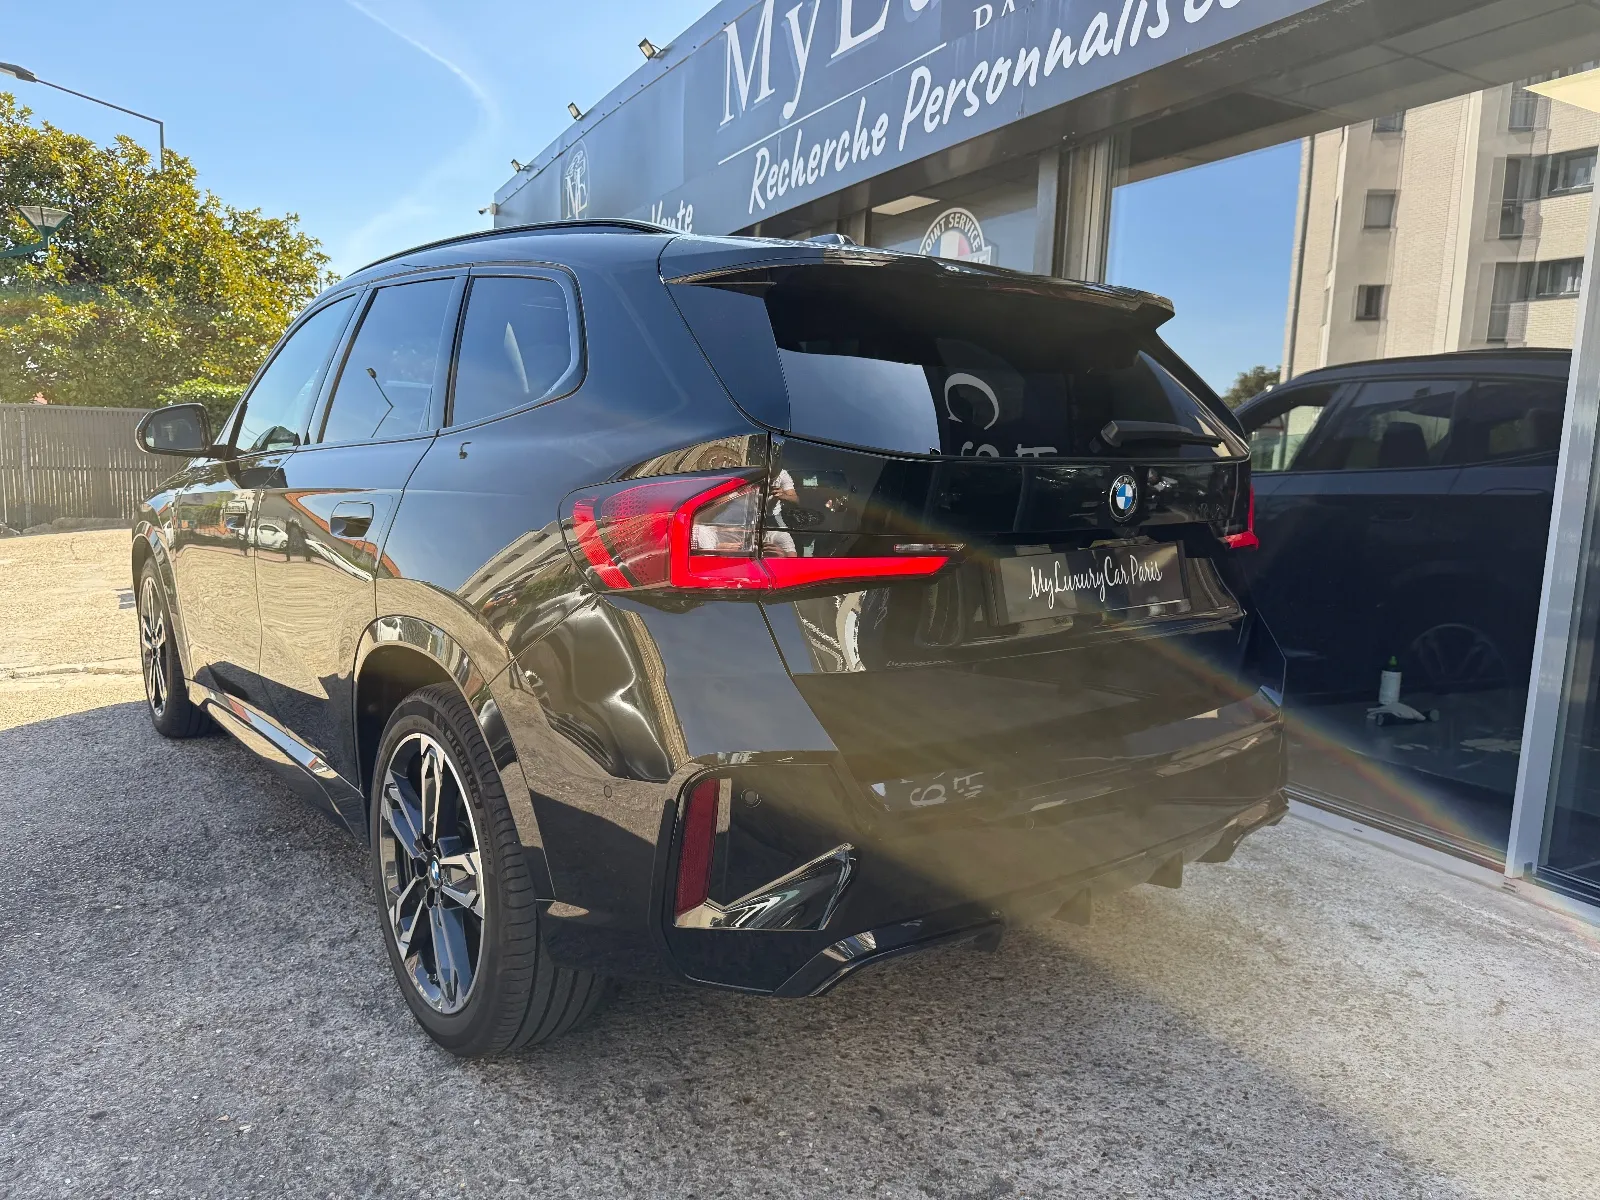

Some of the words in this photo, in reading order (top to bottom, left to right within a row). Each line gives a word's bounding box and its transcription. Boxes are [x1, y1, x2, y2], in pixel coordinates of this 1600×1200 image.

[749, 96, 889, 215] Recherche
[651, 199, 693, 233] Vte
[948, 213, 981, 252] SERVICE
[444, 728, 481, 806] MICHELIN
